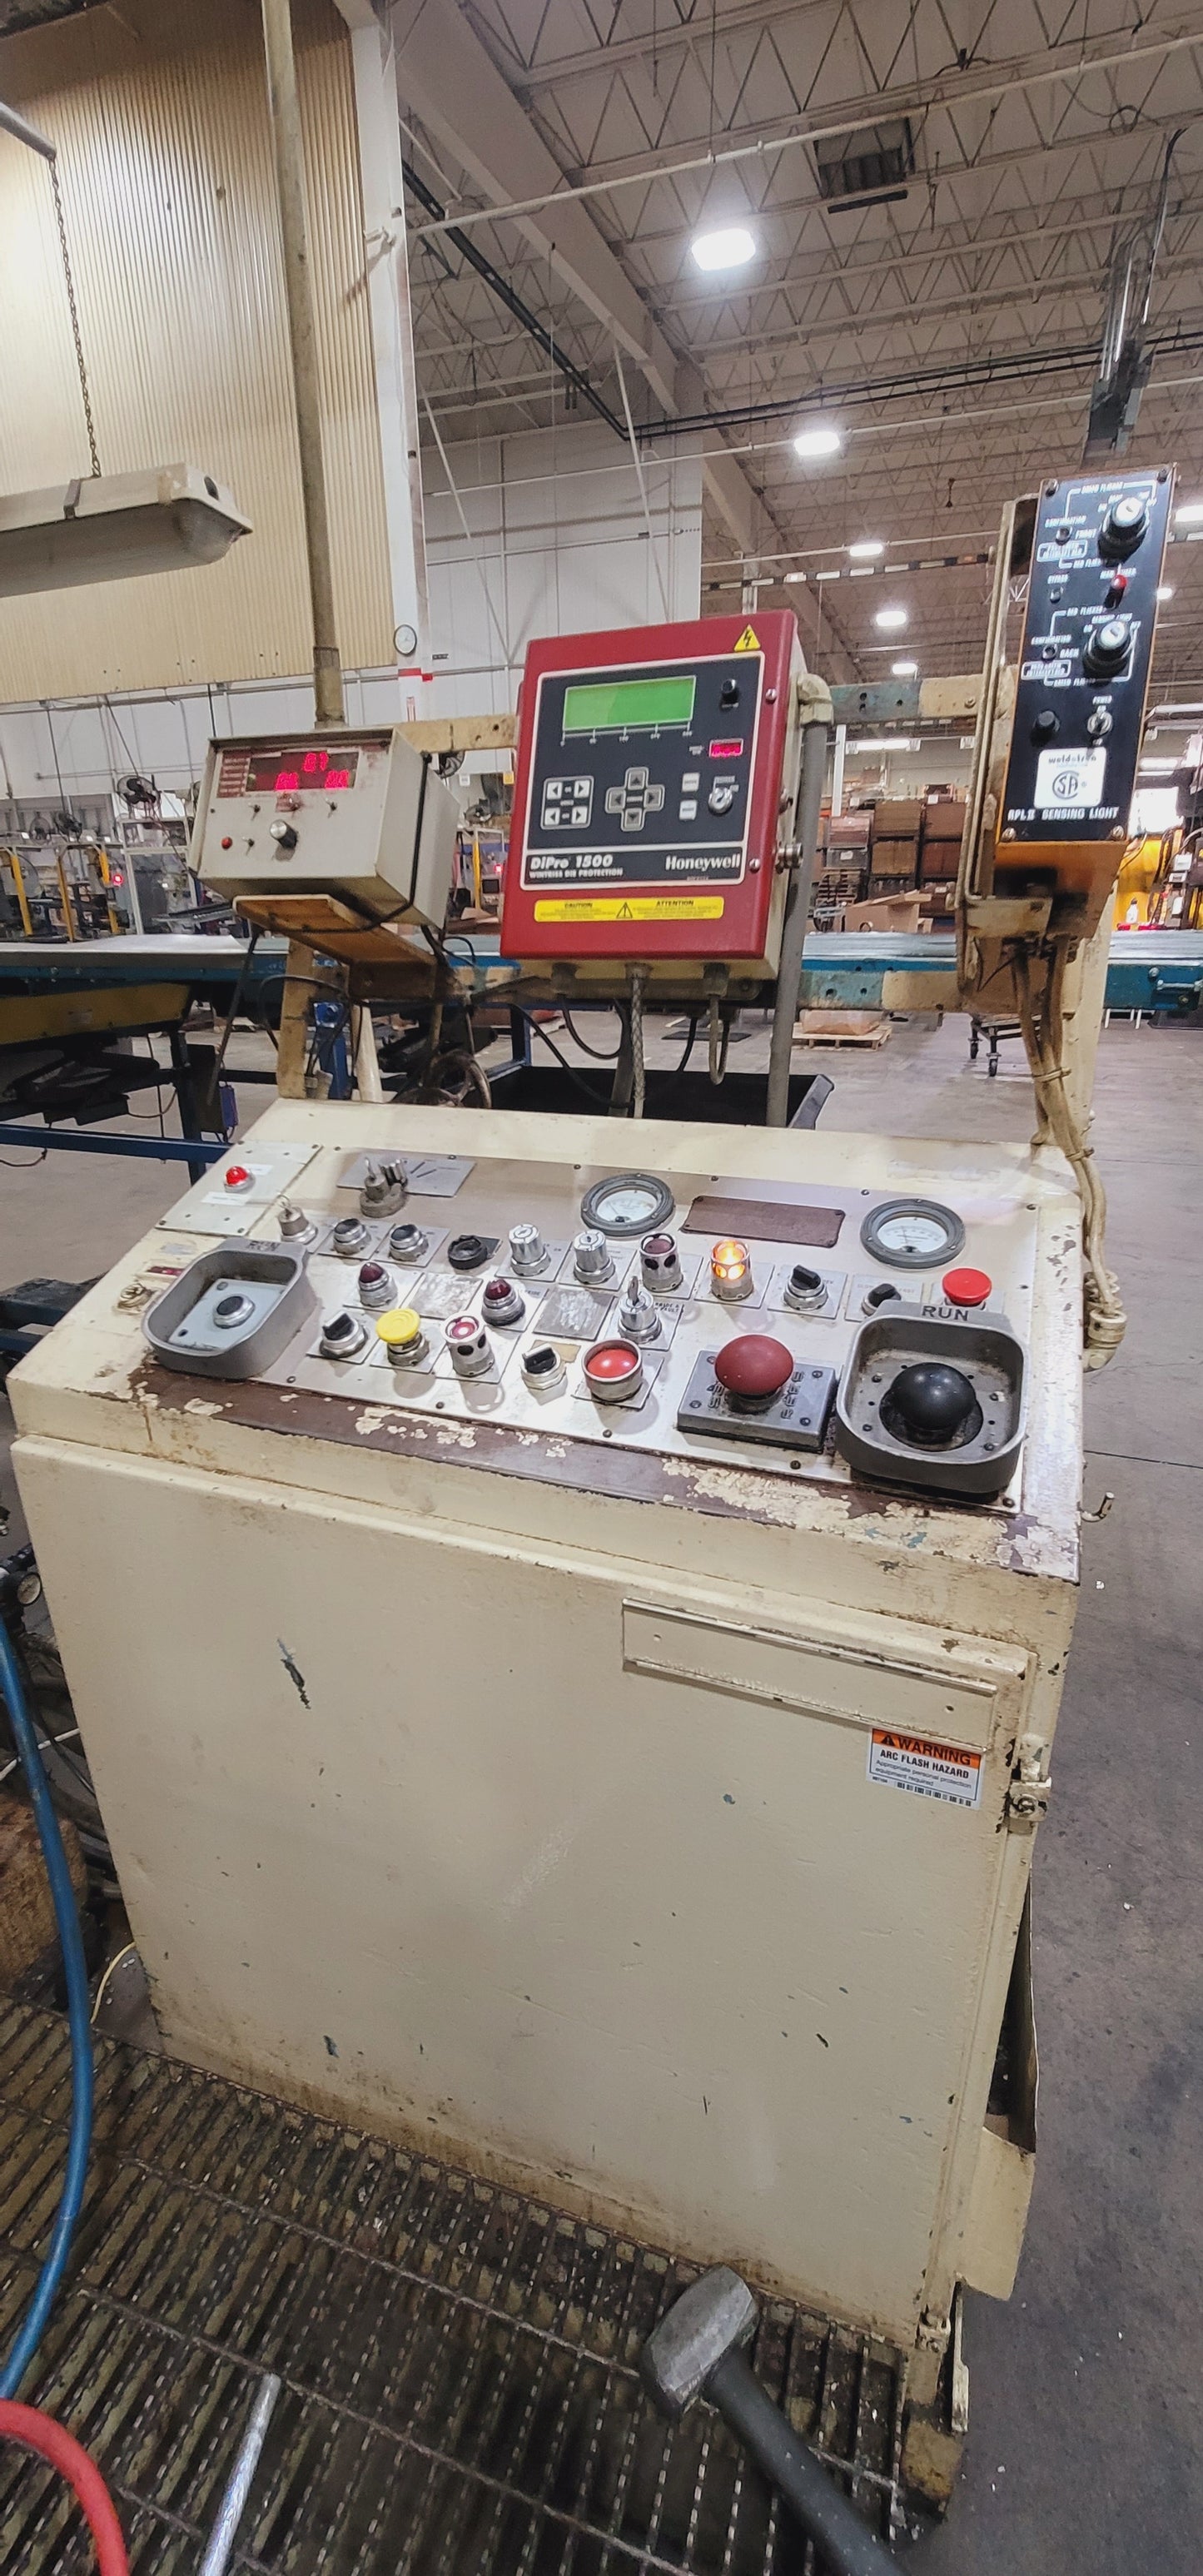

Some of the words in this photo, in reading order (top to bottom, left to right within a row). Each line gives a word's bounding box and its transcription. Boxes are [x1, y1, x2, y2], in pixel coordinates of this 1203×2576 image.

[1041, 808, 1086, 820] SENSING
[1088, 806, 1119, 819] LIGHT
[530, 856, 569, 869] DiPro
[576, 854, 614, 868] 1500
[665, 853, 741, 872] Honeywell
[578, 867, 624, 877] PROTECTION
[922, 1305, 968, 1321] RUN
[897, 1737, 971, 1766] WARNING
[880, 1749, 898, 1762] ARC
[901, 1754, 929, 1769] FLASH
[932, 1762, 969, 1779] HAZARD
[876, 1759, 911, 1773] Appropriate
[912, 1770, 939, 1781] personal
[940, 1777, 972, 1789] protection
[876, 1767, 907, 1780] equipment
[908, 1775, 933, 1787] required
